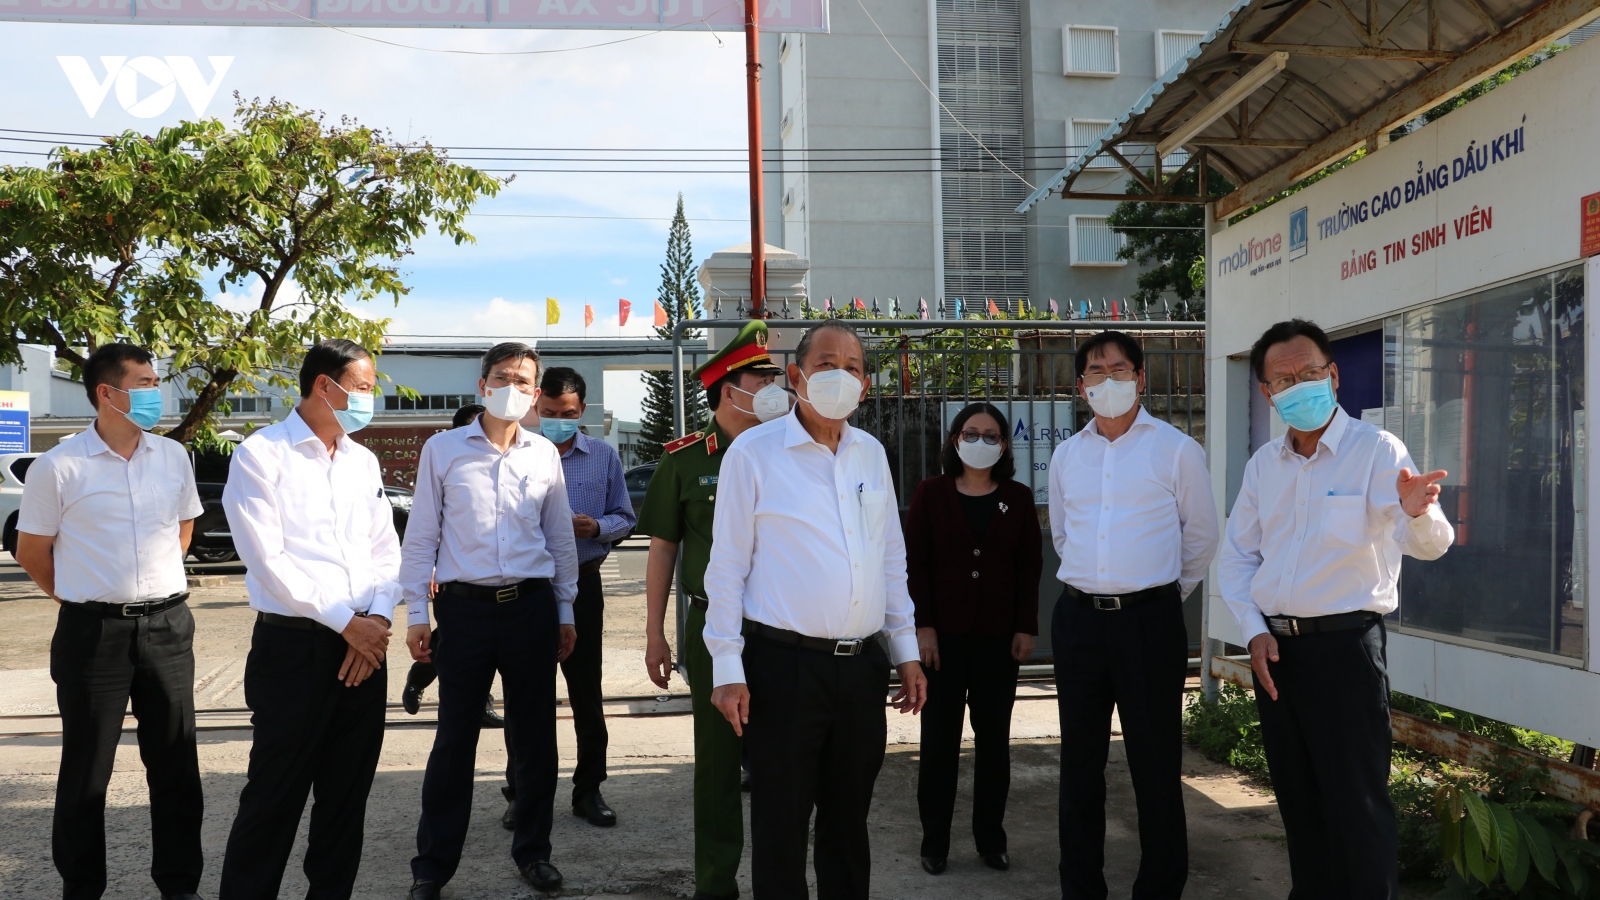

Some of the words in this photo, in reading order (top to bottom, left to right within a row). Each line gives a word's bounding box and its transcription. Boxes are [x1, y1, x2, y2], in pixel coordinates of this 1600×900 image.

[1317, 202, 1368, 241] TRƯỜNG
[1371, 186, 1401, 218] CAO
[1404, 160, 1449, 204] ĐẲNG
[1491, 113, 1525, 165] KHÍ
[1219, 232, 1282, 277] mobifone
[1341, 249, 1377, 281] BẢNG
[1383, 238, 1406, 265] TIN
[1411, 222, 1447, 256] SINH
[1453, 204, 1493, 240] VIÊN
